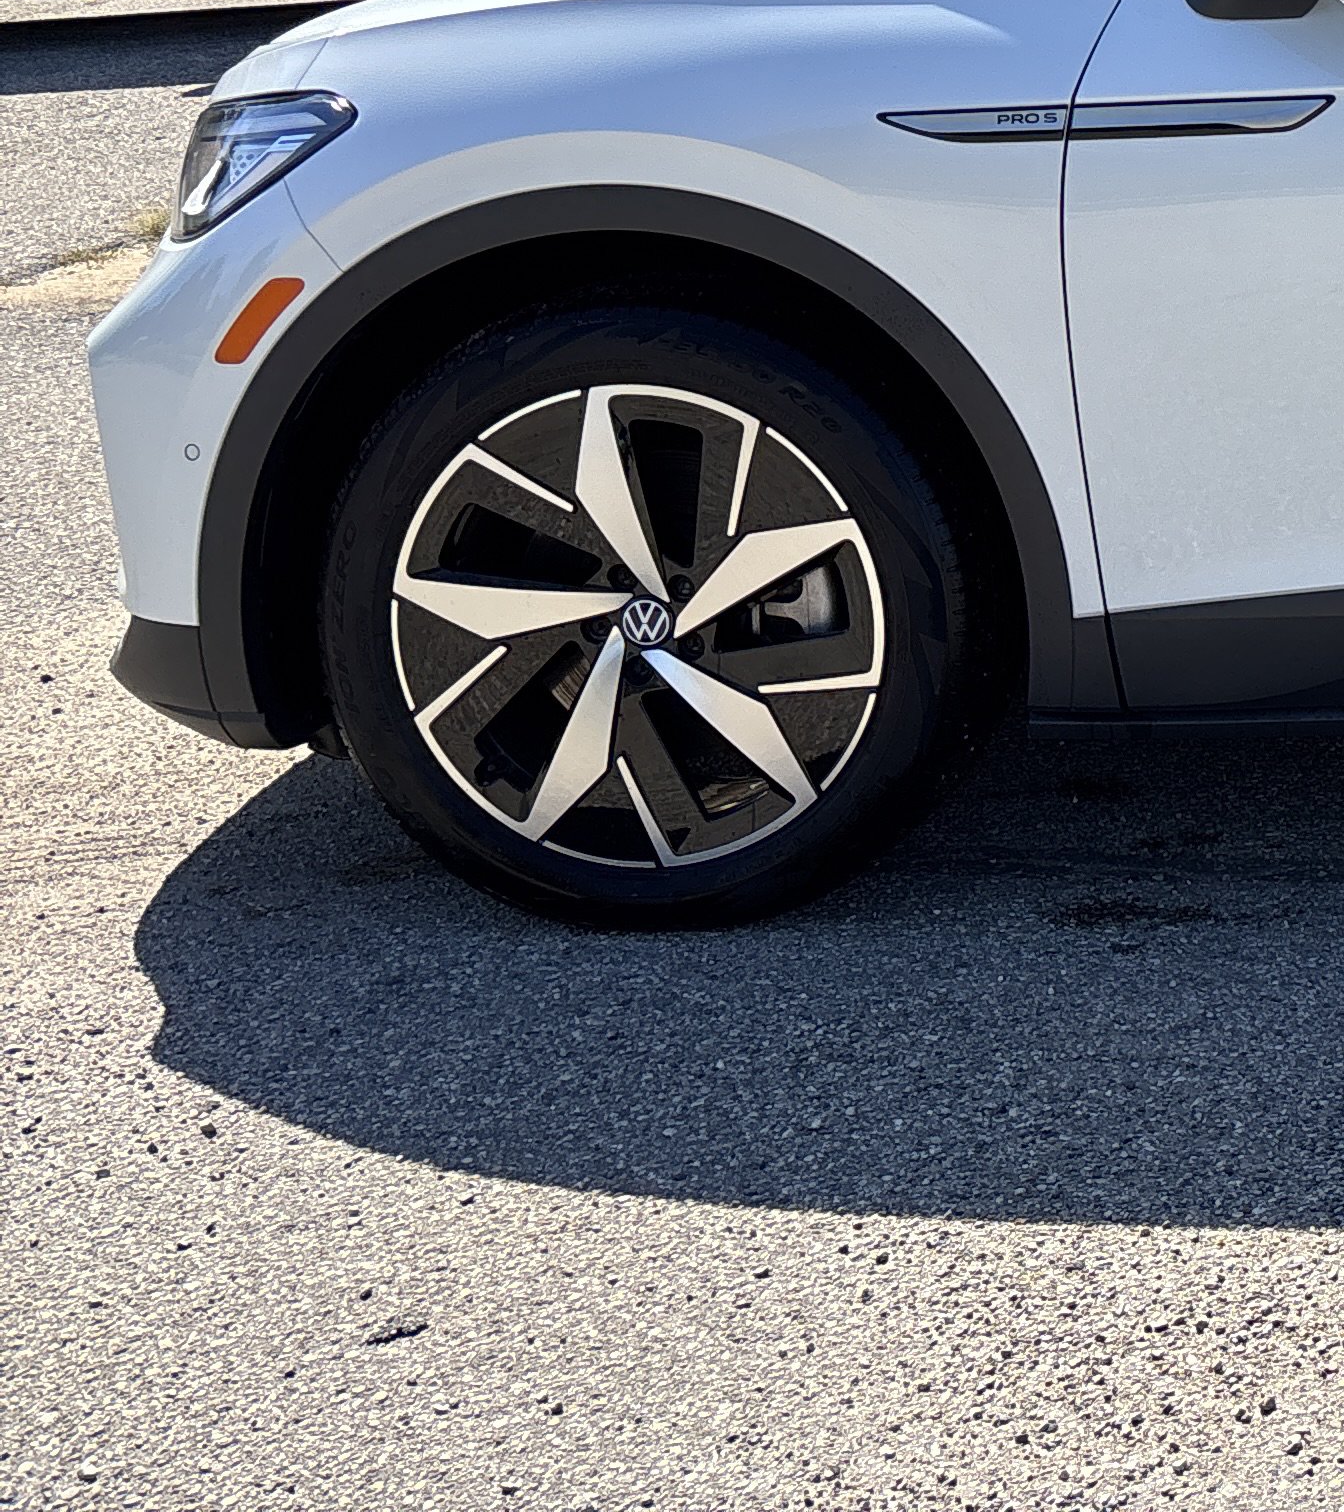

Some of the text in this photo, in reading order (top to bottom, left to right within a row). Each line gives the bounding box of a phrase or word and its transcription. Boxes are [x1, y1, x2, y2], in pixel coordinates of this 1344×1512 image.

[997, 112, 1058, 125] PRO S
[623, 600, 669, 645] VW
